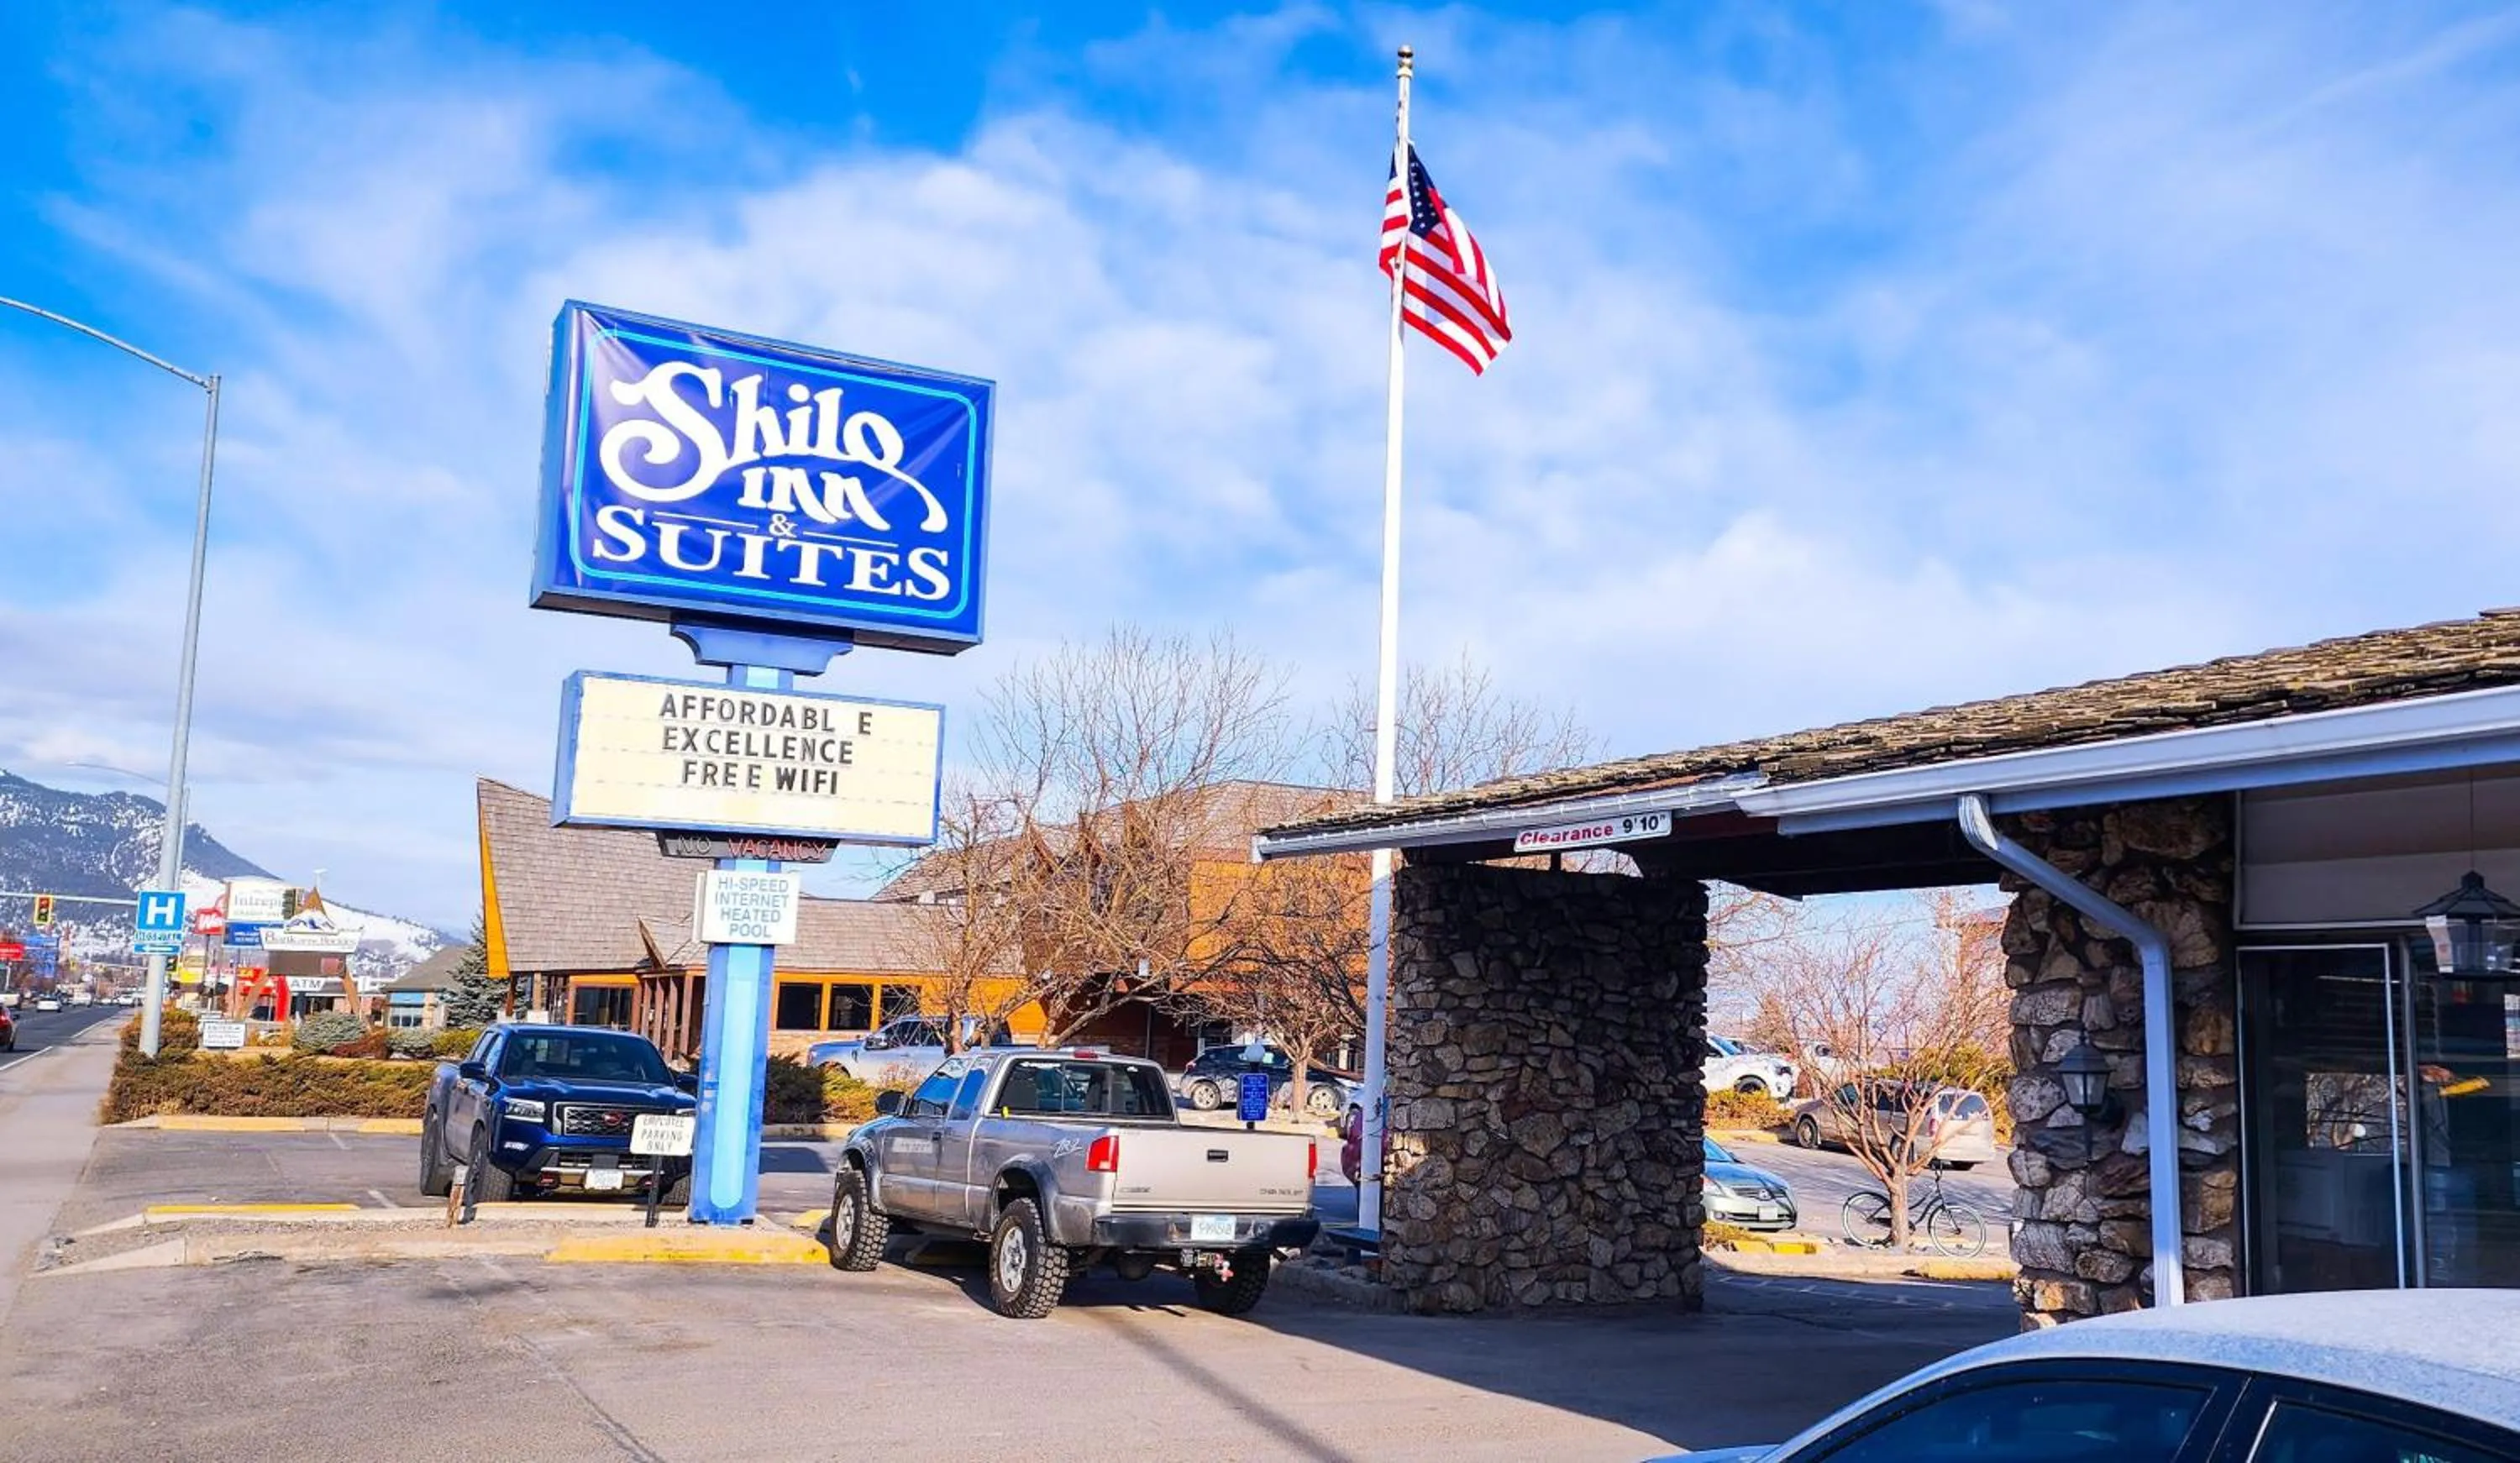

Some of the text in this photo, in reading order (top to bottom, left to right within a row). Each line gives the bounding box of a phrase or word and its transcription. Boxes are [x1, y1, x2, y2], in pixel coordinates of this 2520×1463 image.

[600, 361, 948, 532] Shilo
[768, 513, 798, 537] &
[593, 505, 951, 601] SUITES
[662, 726, 853, 764] EXCELLENCE
[776, 767, 838, 794] WIFI
[1520, 824, 1614, 846] Clearance
[678, 835, 827, 860] NO VACANCY
[717, 876, 789, 893] HI-SPEED
[715, 891, 789, 908] INTERNET
[145, 896, 176, 926] H
[721, 908, 780, 923] HEATED
[729, 923, 772, 937] POOL
[291, 978, 321, 988] ATM
[641, 1129, 682, 1141] PARKING
[646, 1141, 672, 1151] ONLY
[1053, 1139, 1082, 1158] ZR2
